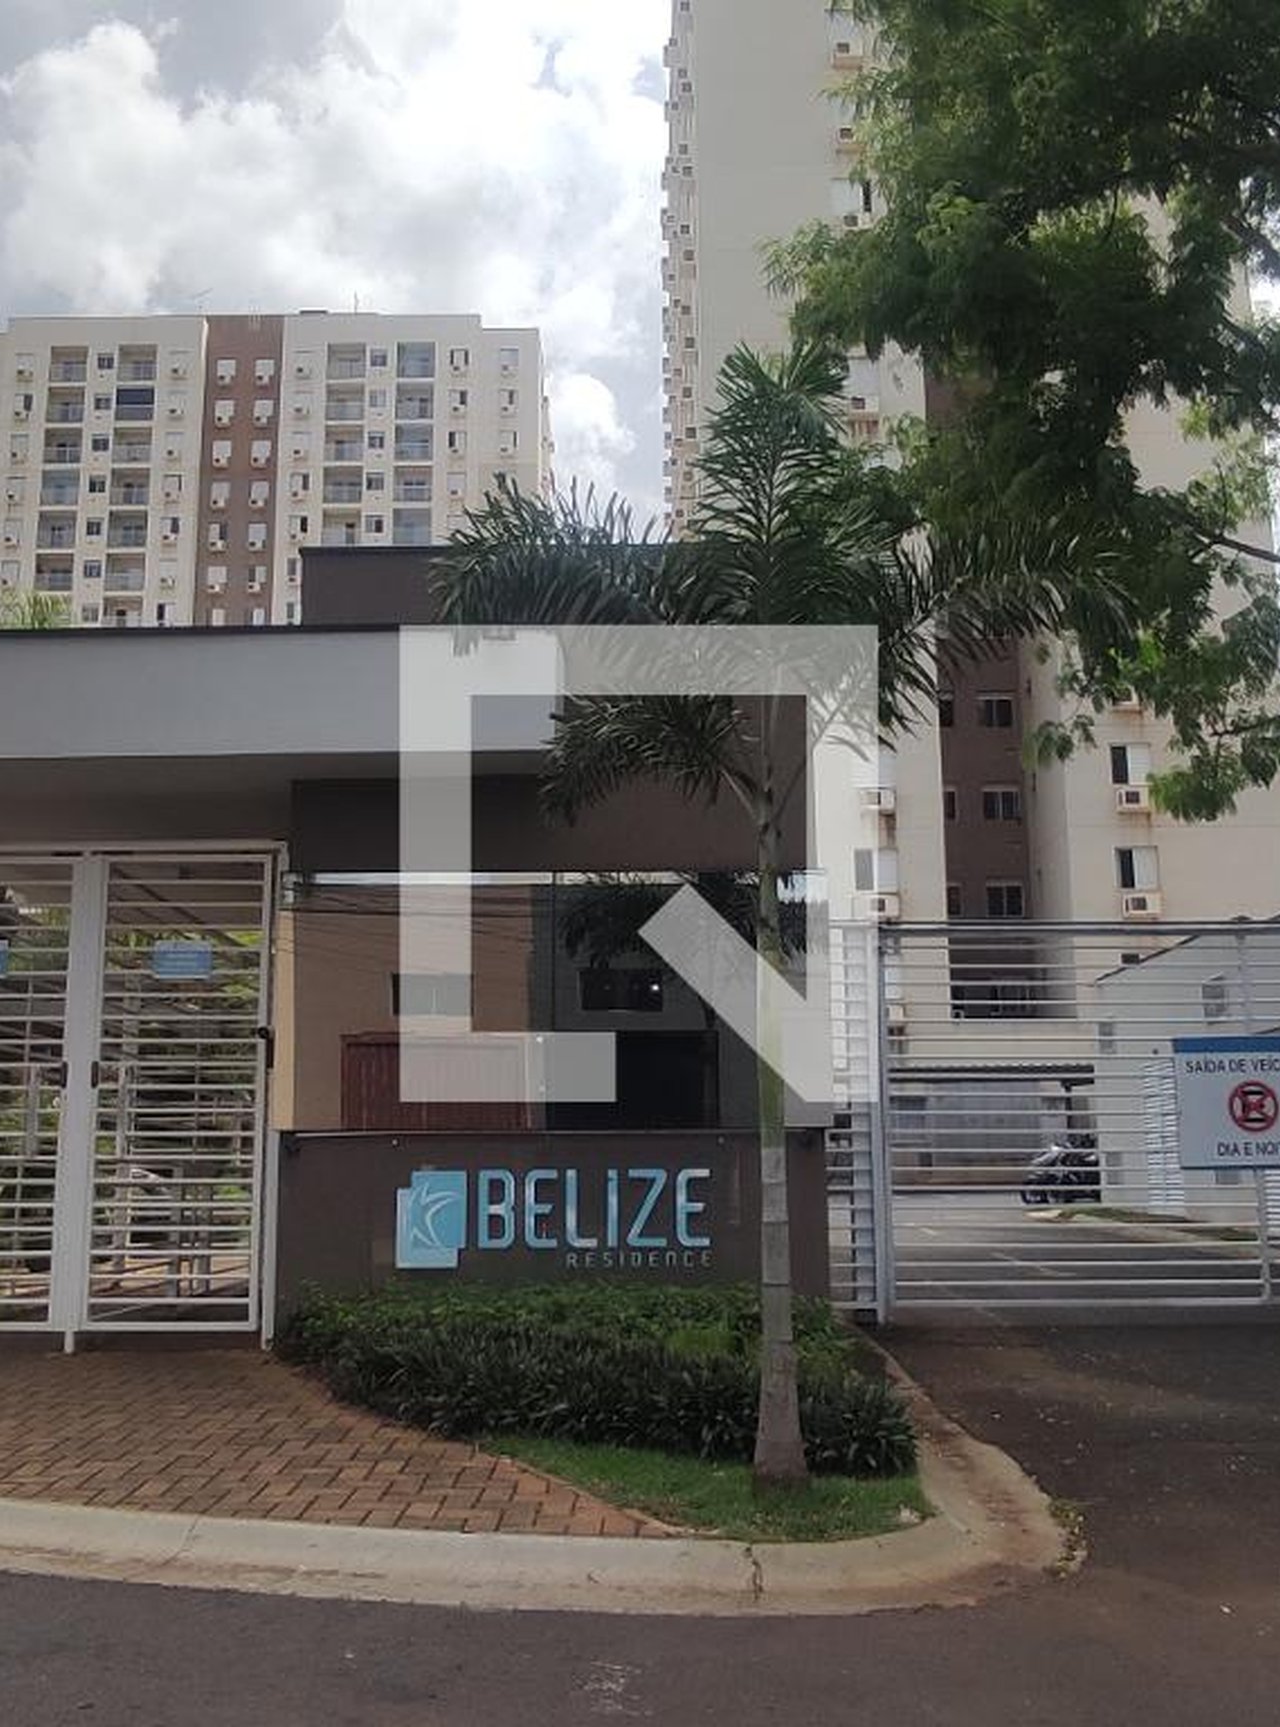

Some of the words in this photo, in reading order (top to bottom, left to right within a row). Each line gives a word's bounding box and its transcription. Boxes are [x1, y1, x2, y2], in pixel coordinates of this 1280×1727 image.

[1185, 1057, 1226, 1074] SAÍDA
[1228, 1059, 1248, 1074] DE
[1217, 1142, 1242, 1157] DIA
[1244, 1141, 1255, 1156] E
[477, 1168, 712, 1249] BELIZE
[566, 1251, 713, 1269] RESIDENCE
